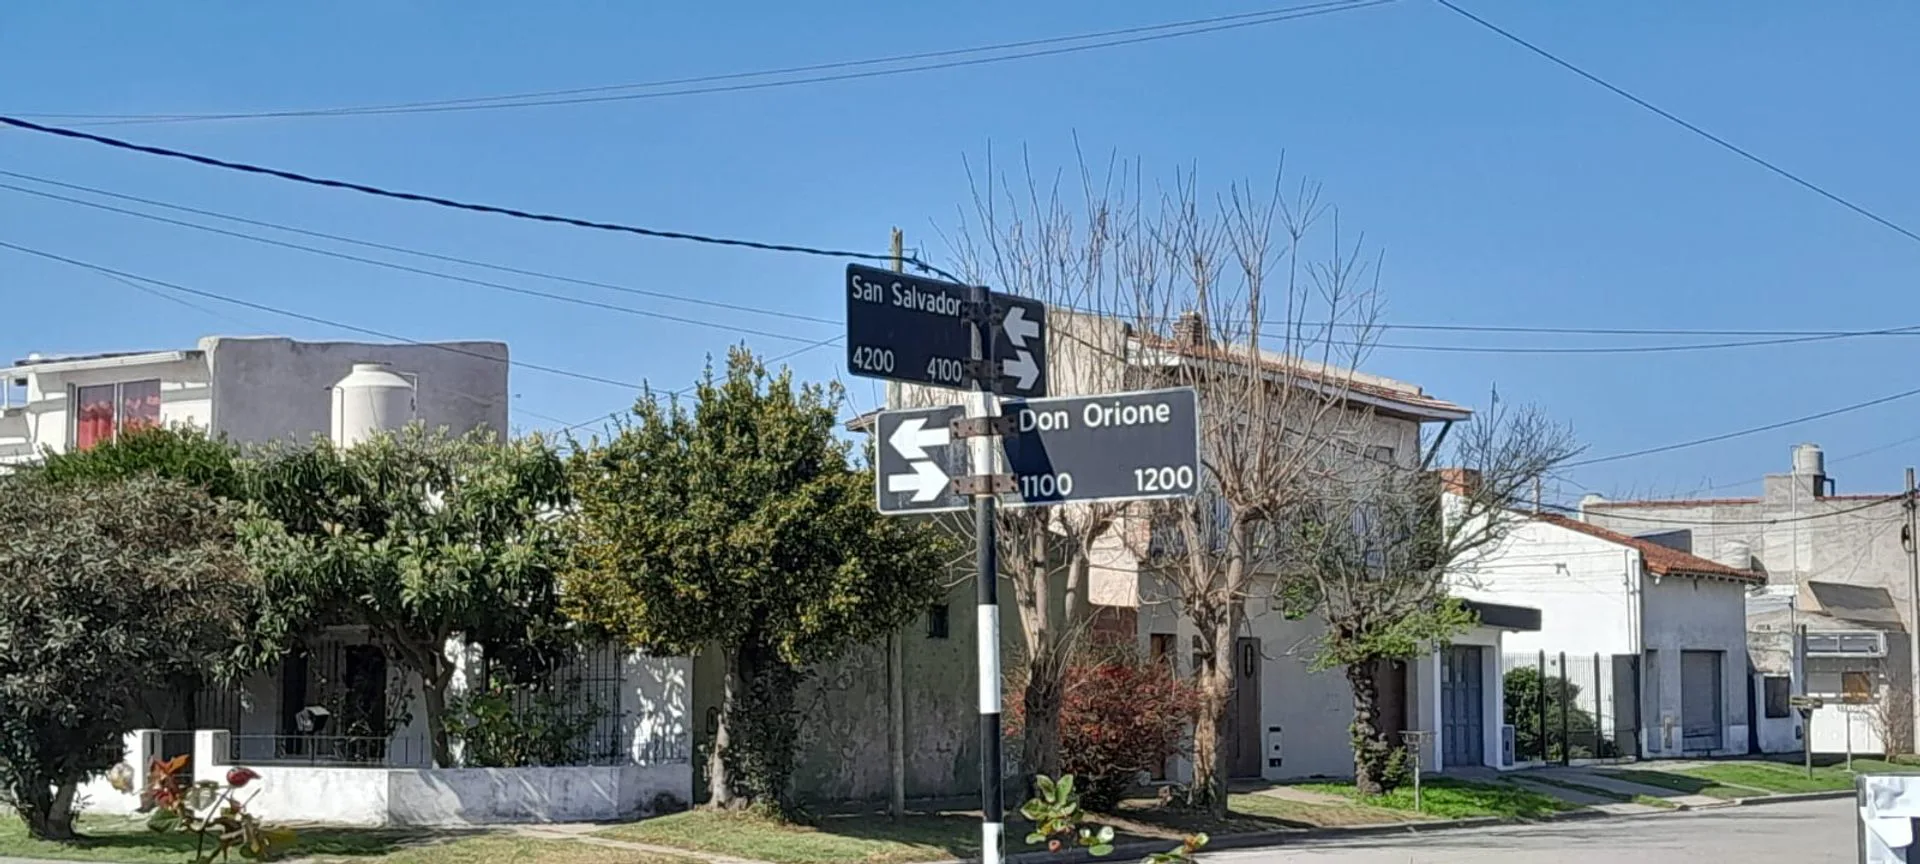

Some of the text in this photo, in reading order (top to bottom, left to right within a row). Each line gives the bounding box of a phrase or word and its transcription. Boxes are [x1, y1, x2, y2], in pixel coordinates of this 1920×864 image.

[852, 275, 962, 317] San Salvador
[853, 346, 963, 383] 4200 4100
[1019, 401, 1170, 433] Don Orione
[1021, 465, 1193, 498] 1100 1200
